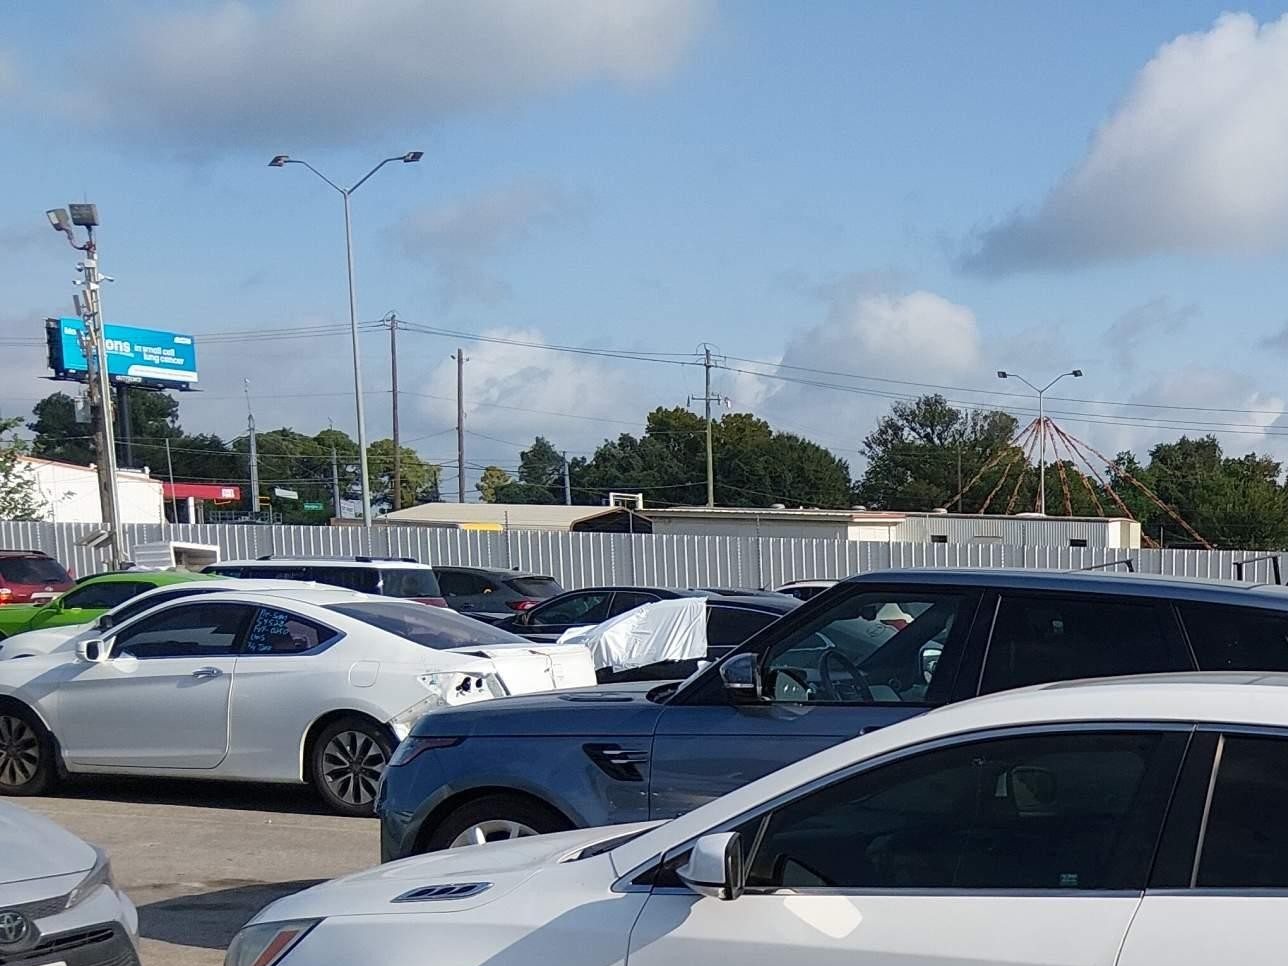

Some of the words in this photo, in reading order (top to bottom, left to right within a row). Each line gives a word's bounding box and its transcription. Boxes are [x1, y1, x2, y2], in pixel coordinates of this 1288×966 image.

[105, 339, 131, 353] ons
[143, 346, 162, 355] small
[143, 353, 160, 364] lung
[160, 355, 184, 365] cancer
